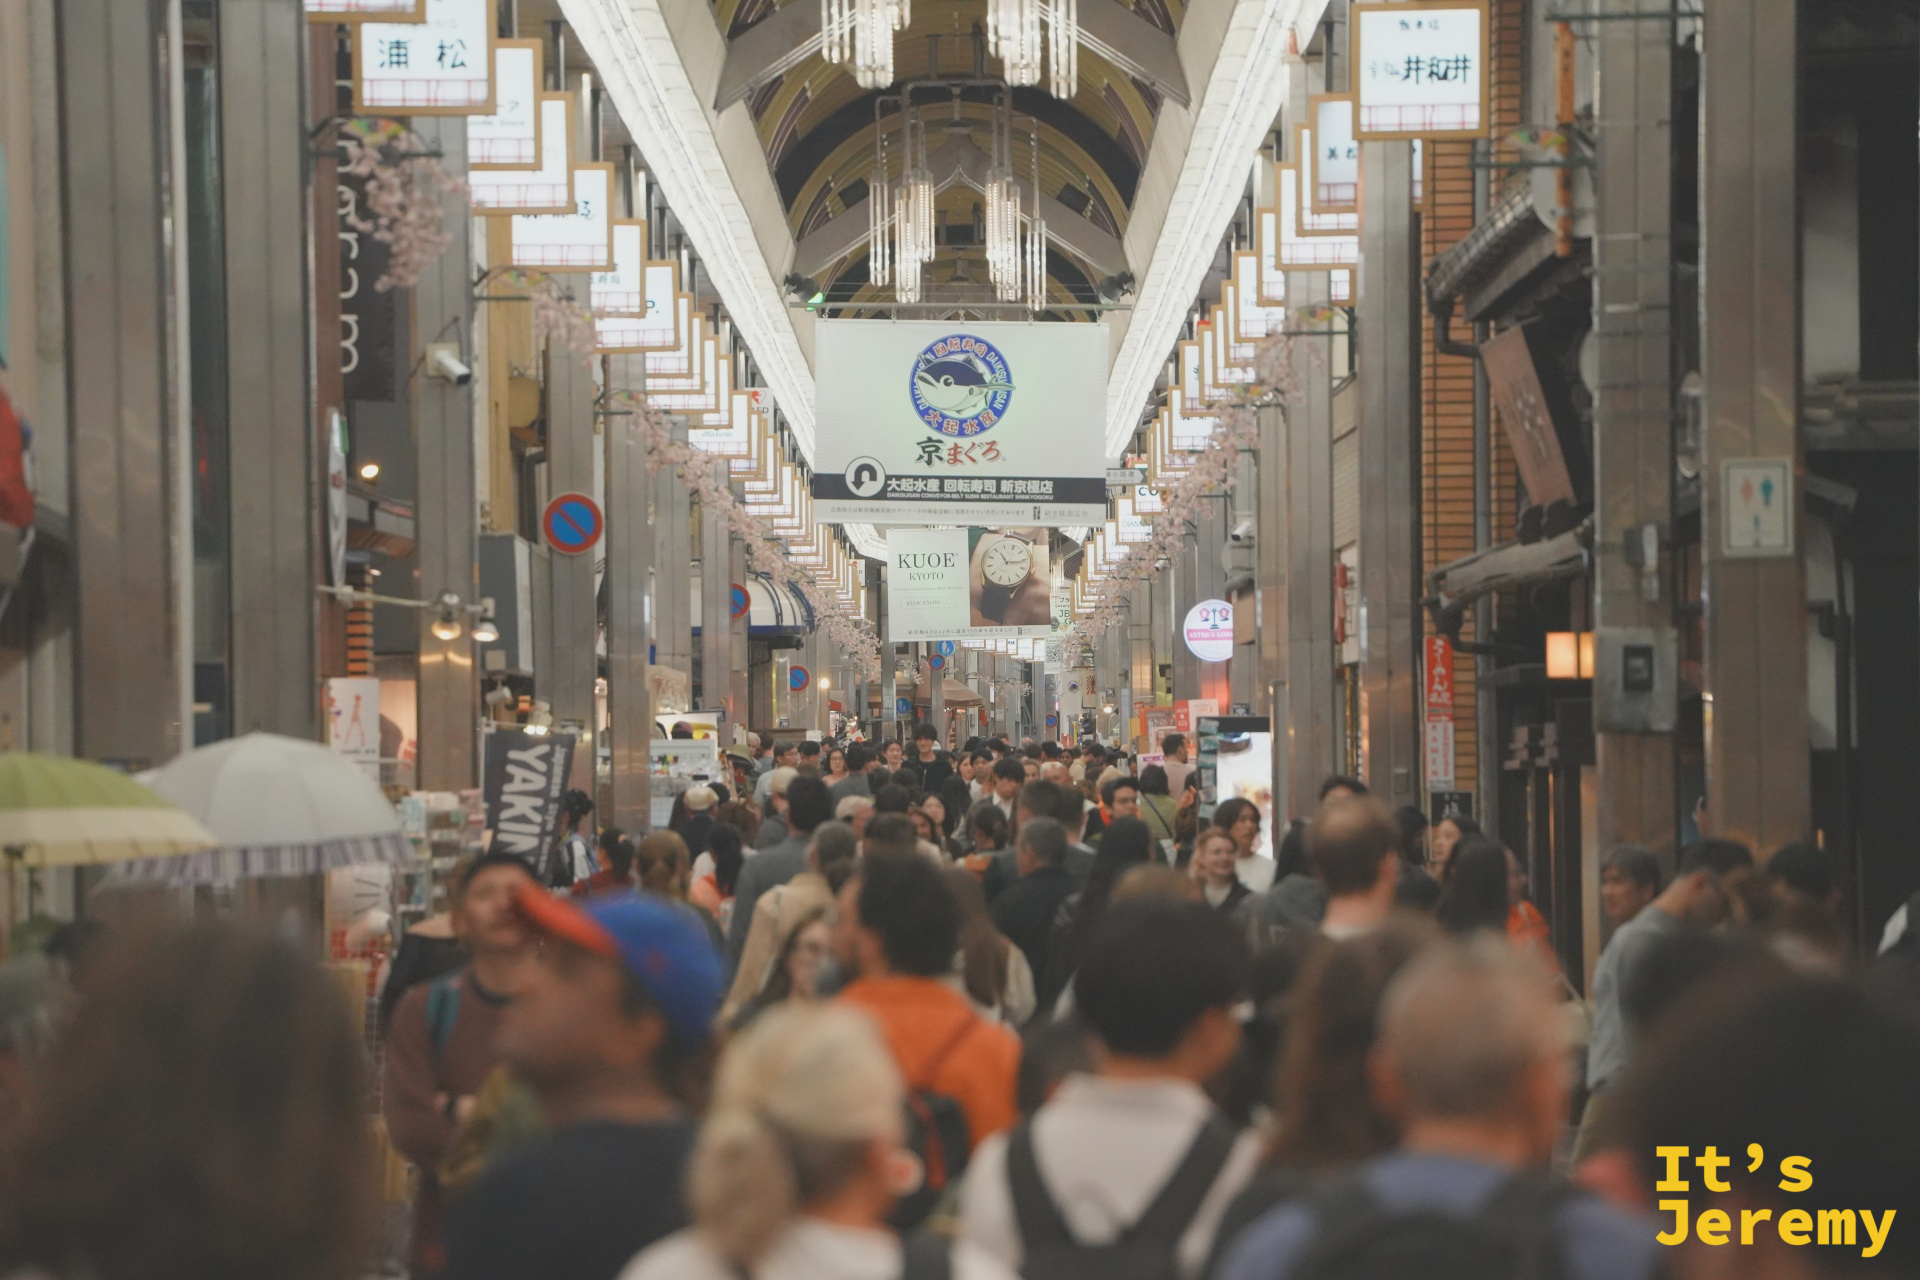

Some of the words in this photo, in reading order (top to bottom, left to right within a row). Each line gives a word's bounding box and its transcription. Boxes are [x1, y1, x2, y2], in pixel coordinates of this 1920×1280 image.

[933, 337, 988, 358] 回転寿司
[924, 409, 998, 435] 大起水産
[915, 436, 1002, 467] 京まぐろ
[887, 478, 940, 492] 大起水産
[944, 479, 996, 493] 回転寿司
[1000, 480, 1054, 494] 新京極店
[898, 553, 955, 569] KUOE
[909, 572, 944, 581] KYOTO
[496, 743, 551, 864] YAKIN
